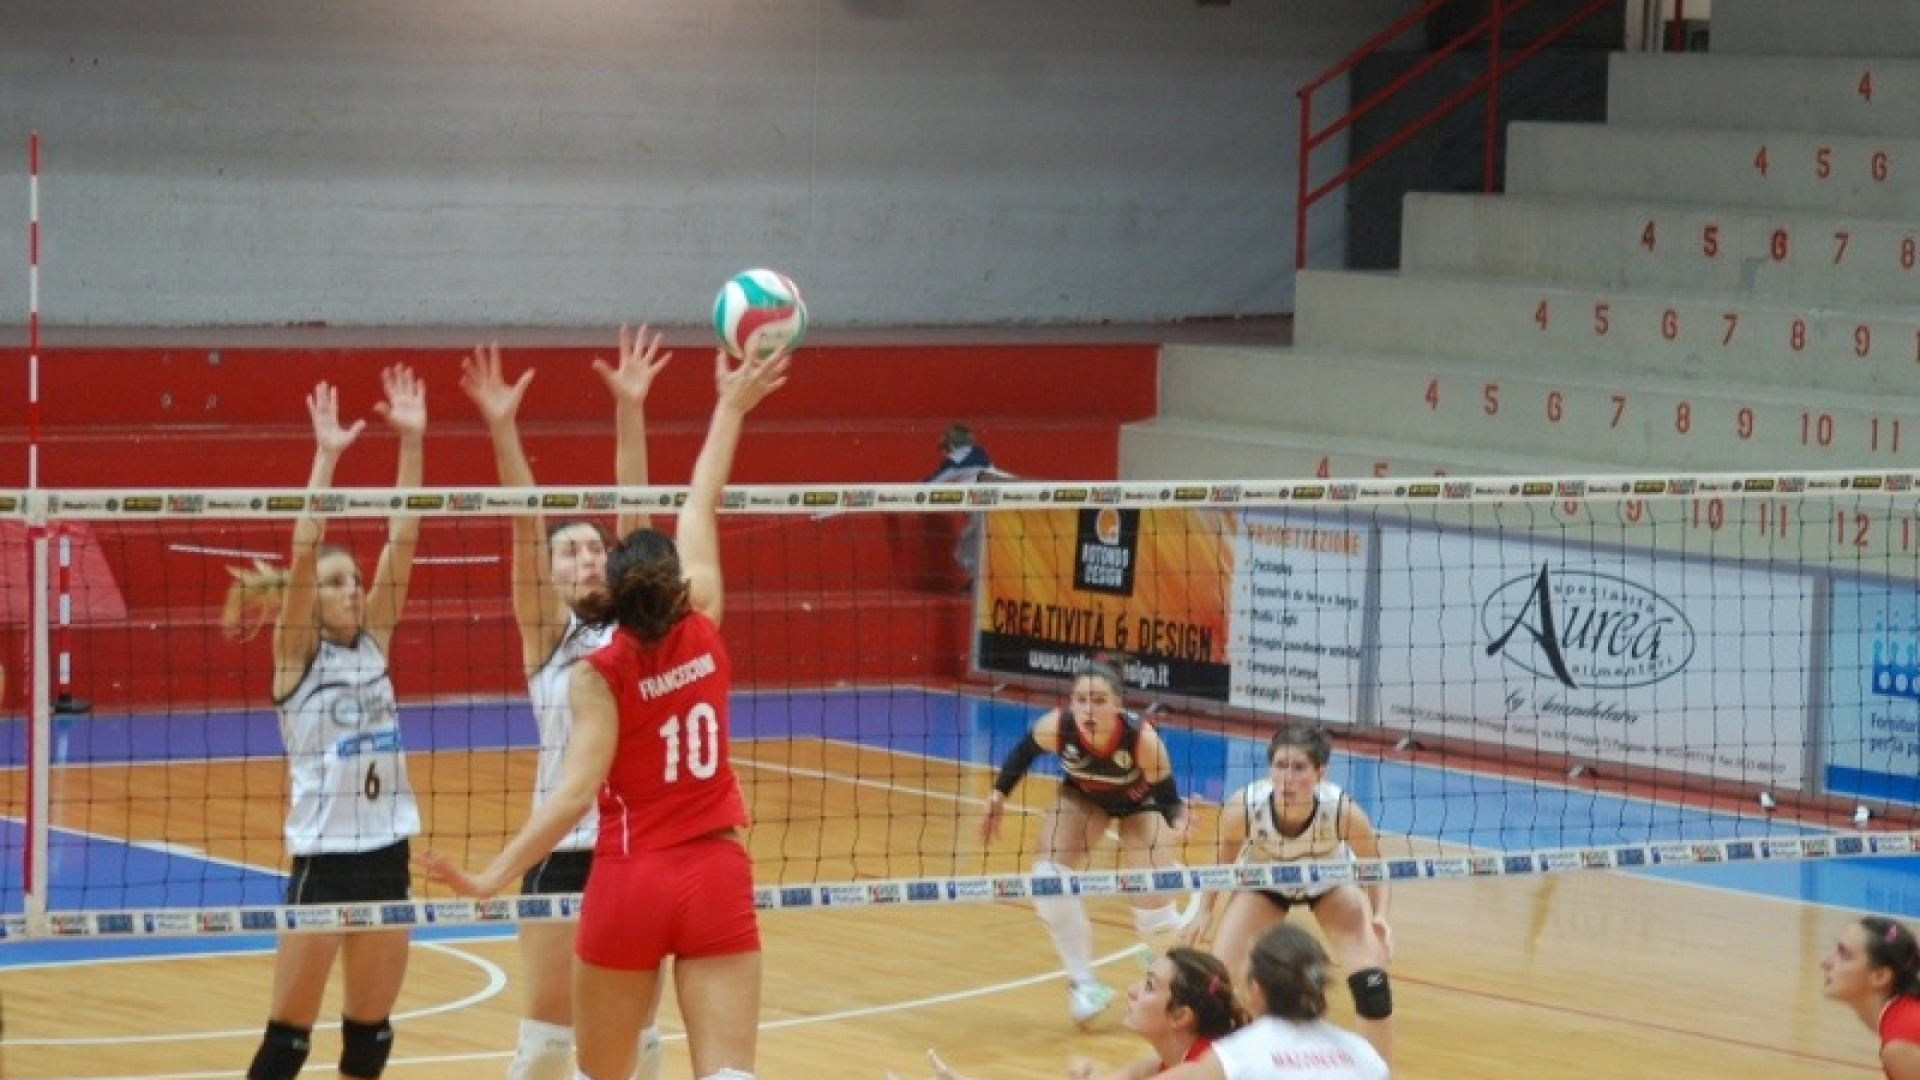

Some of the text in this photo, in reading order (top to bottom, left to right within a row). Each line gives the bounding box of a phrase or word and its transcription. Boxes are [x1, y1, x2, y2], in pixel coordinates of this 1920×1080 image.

[1857, 70, 1873, 101] 4
[1754, 145, 1768, 176] 4
[1816, 148, 1831, 179] 5
[1641, 221, 1657, 253] 4
[1703, 226, 1719, 258] 5
[1833, 232, 1849, 264] 7
[1901, 237, 1916, 269] 8
[1535, 300, 1549, 331] 4
[1595, 305, 1609, 336] 5
[1722, 314, 1738, 346] 7
[1790, 319, 1806, 351] 8
[1854, 325, 1870, 358] 9
[1425, 379, 1439, 411] 4
[1485, 384, 1499, 416] 5
[1610, 395, 1626, 428] 7
[1675, 402, 1691, 433] 8
[1737, 408, 1753, 440] 9
[1802, 412, 1833, 446] 10
[1871, 417, 1900, 453] 11
[1693, 499, 1724, 531] 10
[1760, 502, 1788, 539] 11
[1837, 510, 1870, 548] 12
[993, 597, 1105, 648] CREATIVITÀ
[1139, 617, 1213, 663] DESIGN
[1486, 558, 1674, 690] Aurea
[659, 702, 719, 784] 10
[364, 761, 381, 802] 6
